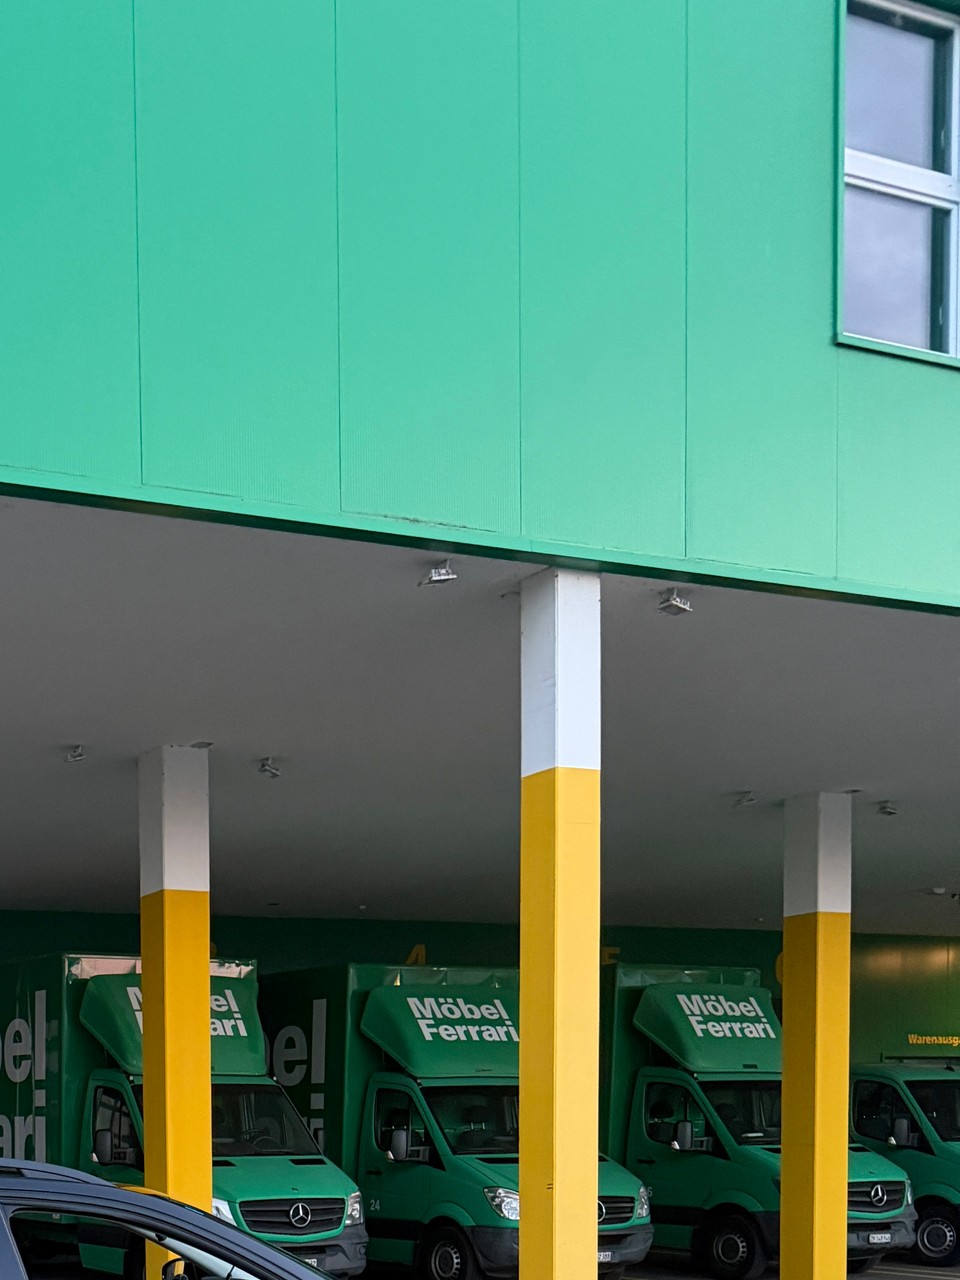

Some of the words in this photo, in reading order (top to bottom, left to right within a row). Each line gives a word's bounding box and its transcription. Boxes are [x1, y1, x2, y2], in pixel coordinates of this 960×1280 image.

[406, 997, 509, 1020] Möbel
[676, 994, 764, 1017] Möbel
[417, 1019, 520, 1042] Ferrari
[687, 1015, 777, 1039] Ferrari
[370, 1199, 381, 1211] 24
